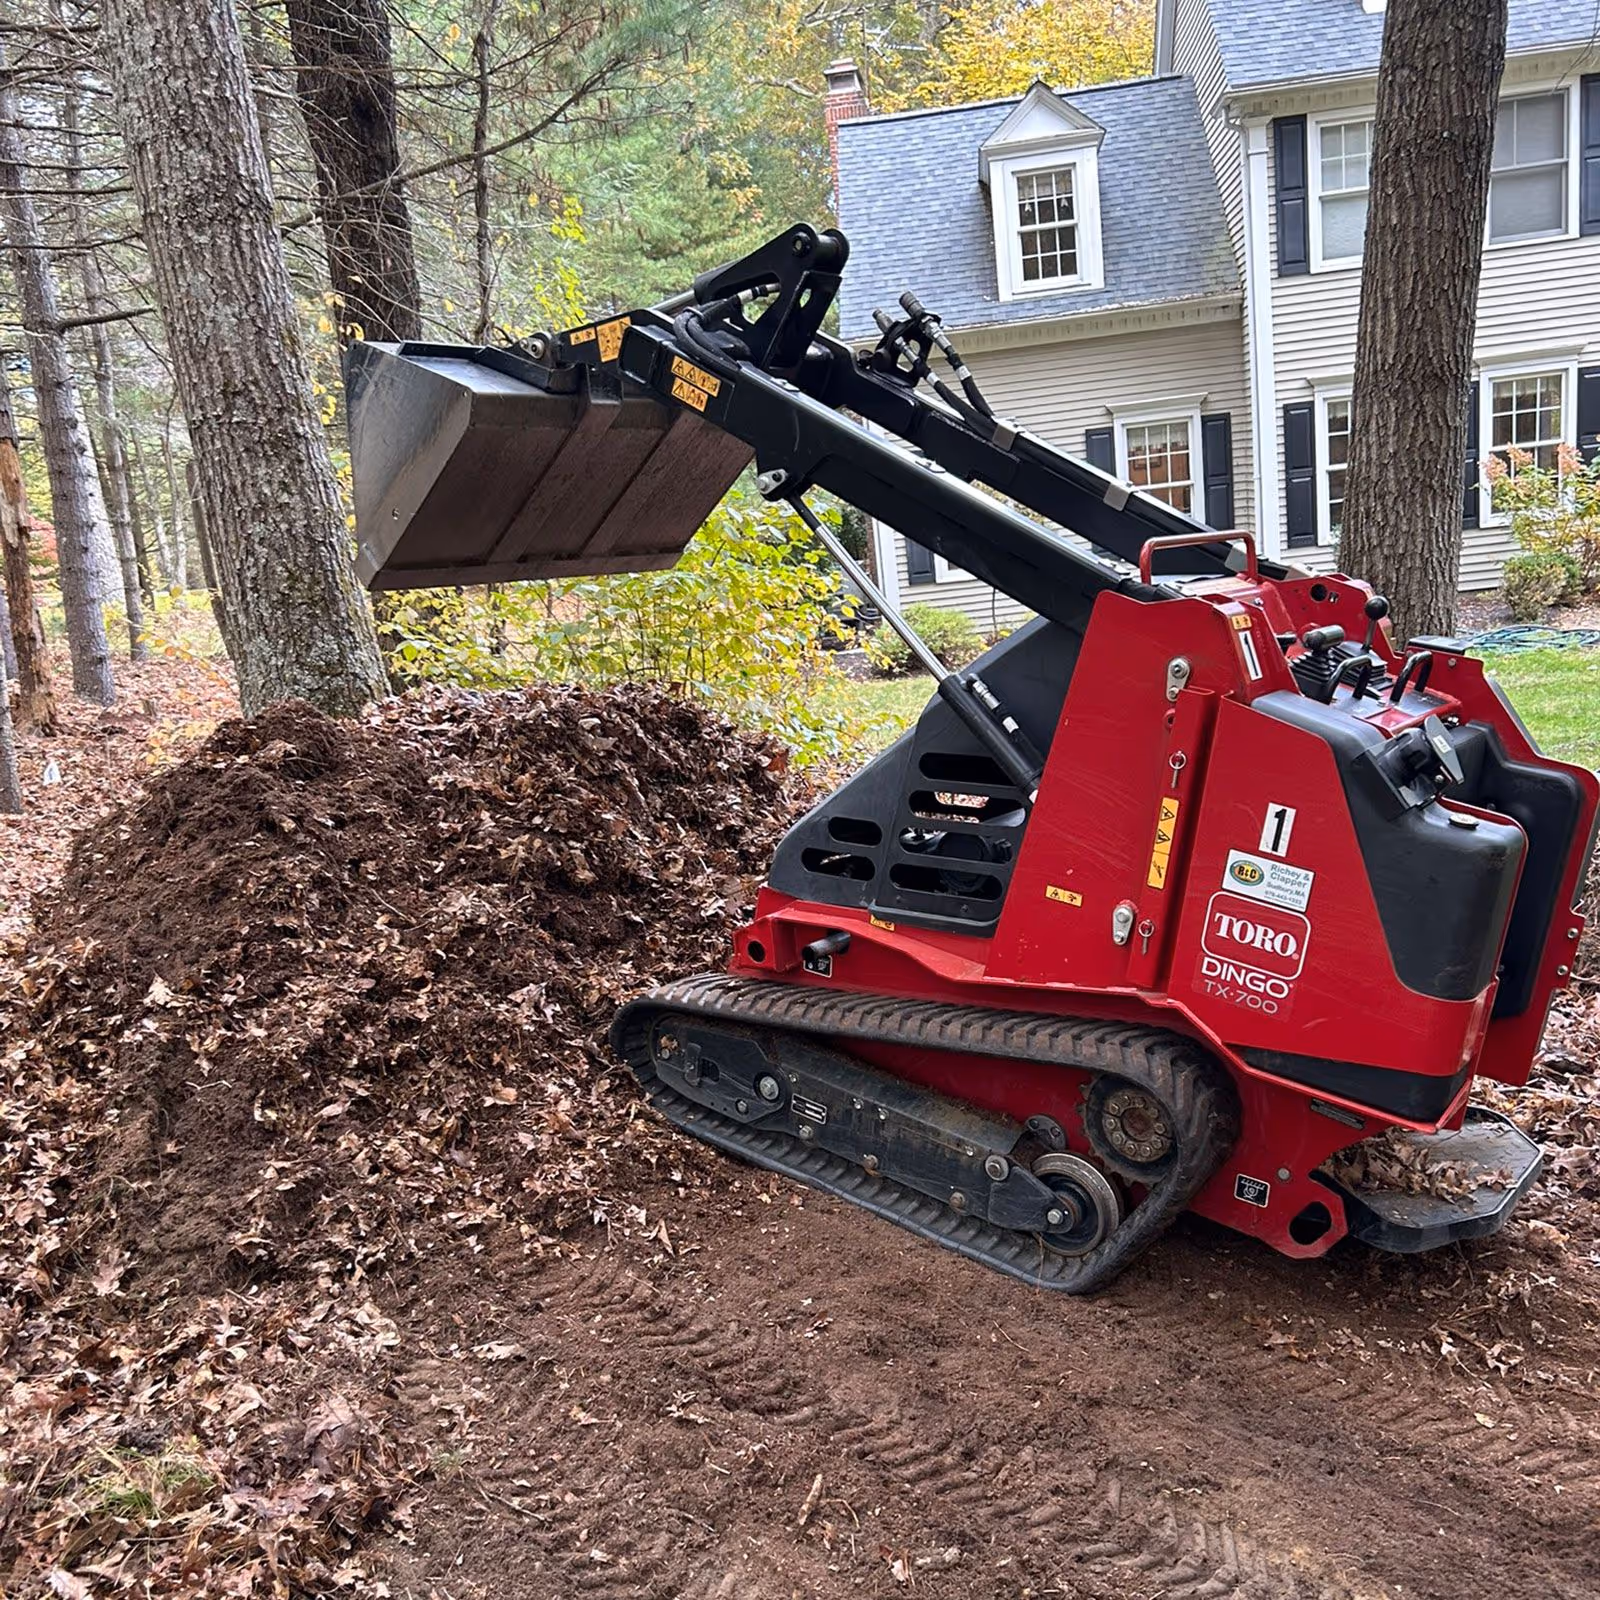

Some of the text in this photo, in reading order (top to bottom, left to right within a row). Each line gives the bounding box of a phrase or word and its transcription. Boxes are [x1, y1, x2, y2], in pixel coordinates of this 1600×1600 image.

[1244, 633, 1259, 677] 1
[1271, 808, 1287, 853] 1
[1270, 864, 1310, 881] Richey &
[1270, 872, 1308, 888] Clapper
[1214, 912, 1298, 957] TORO
[1201, 956, 1289, 999] DINGO
